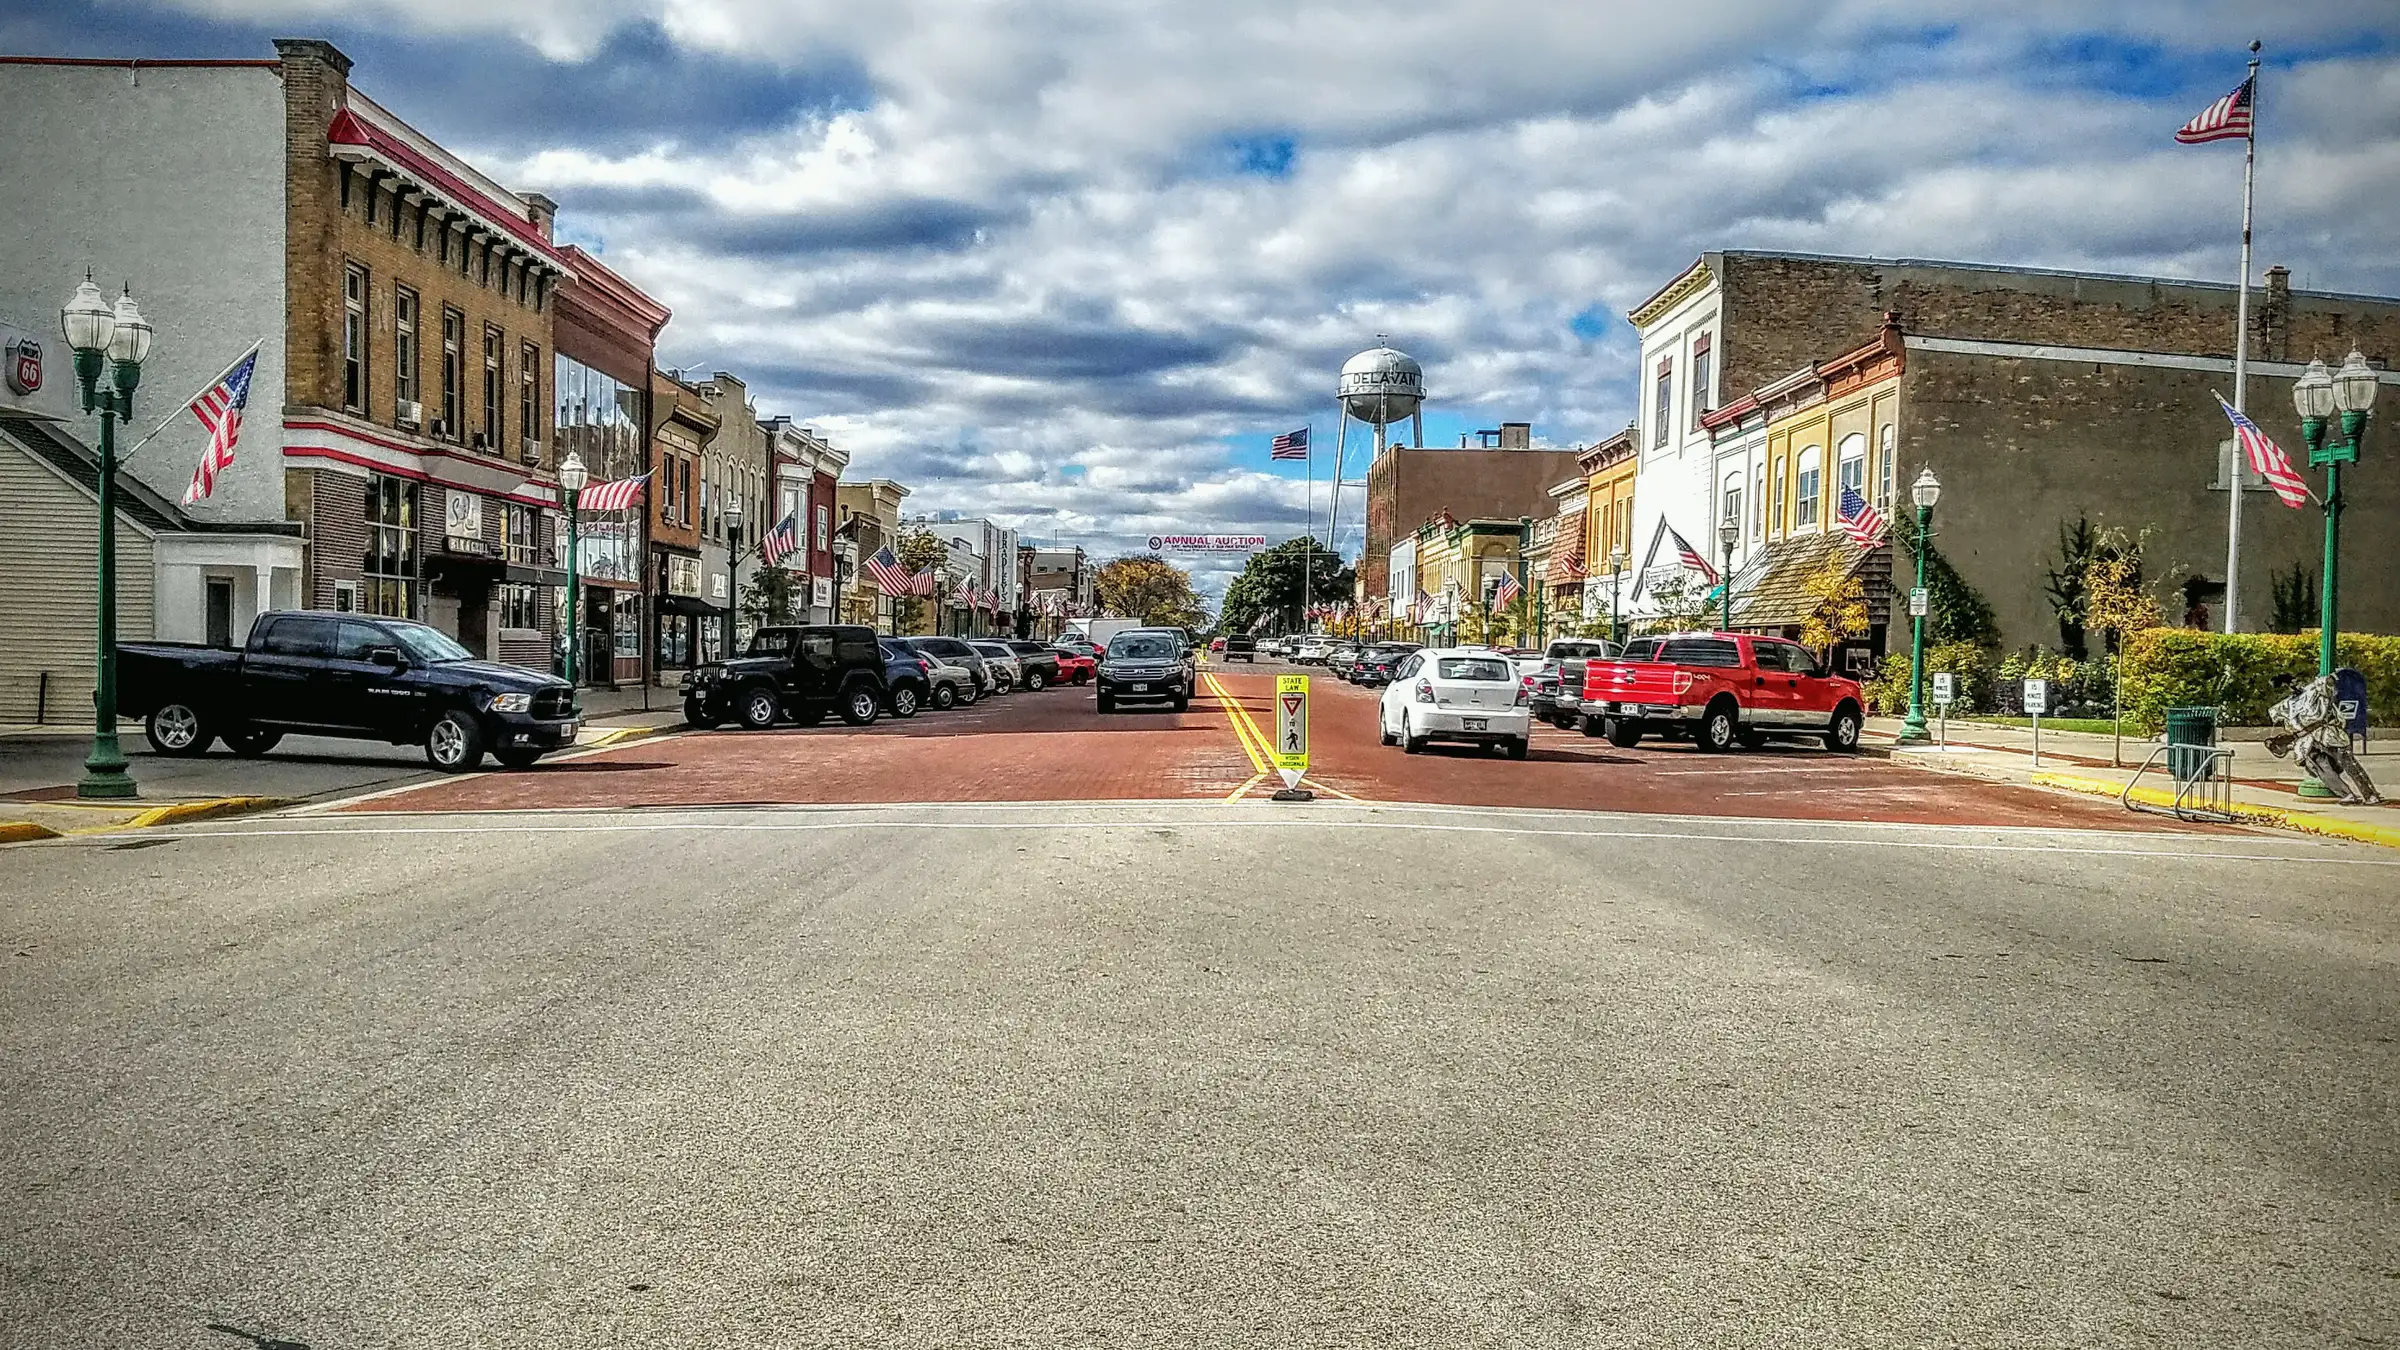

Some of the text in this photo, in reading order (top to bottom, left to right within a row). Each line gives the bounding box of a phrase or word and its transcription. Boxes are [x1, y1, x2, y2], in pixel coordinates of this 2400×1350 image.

[22, 361, 37, 381] 66
[1353, 372, 1416, 386] DELAVAN
[1164, 536, 1265, 545] ANNUAL AUCTION
